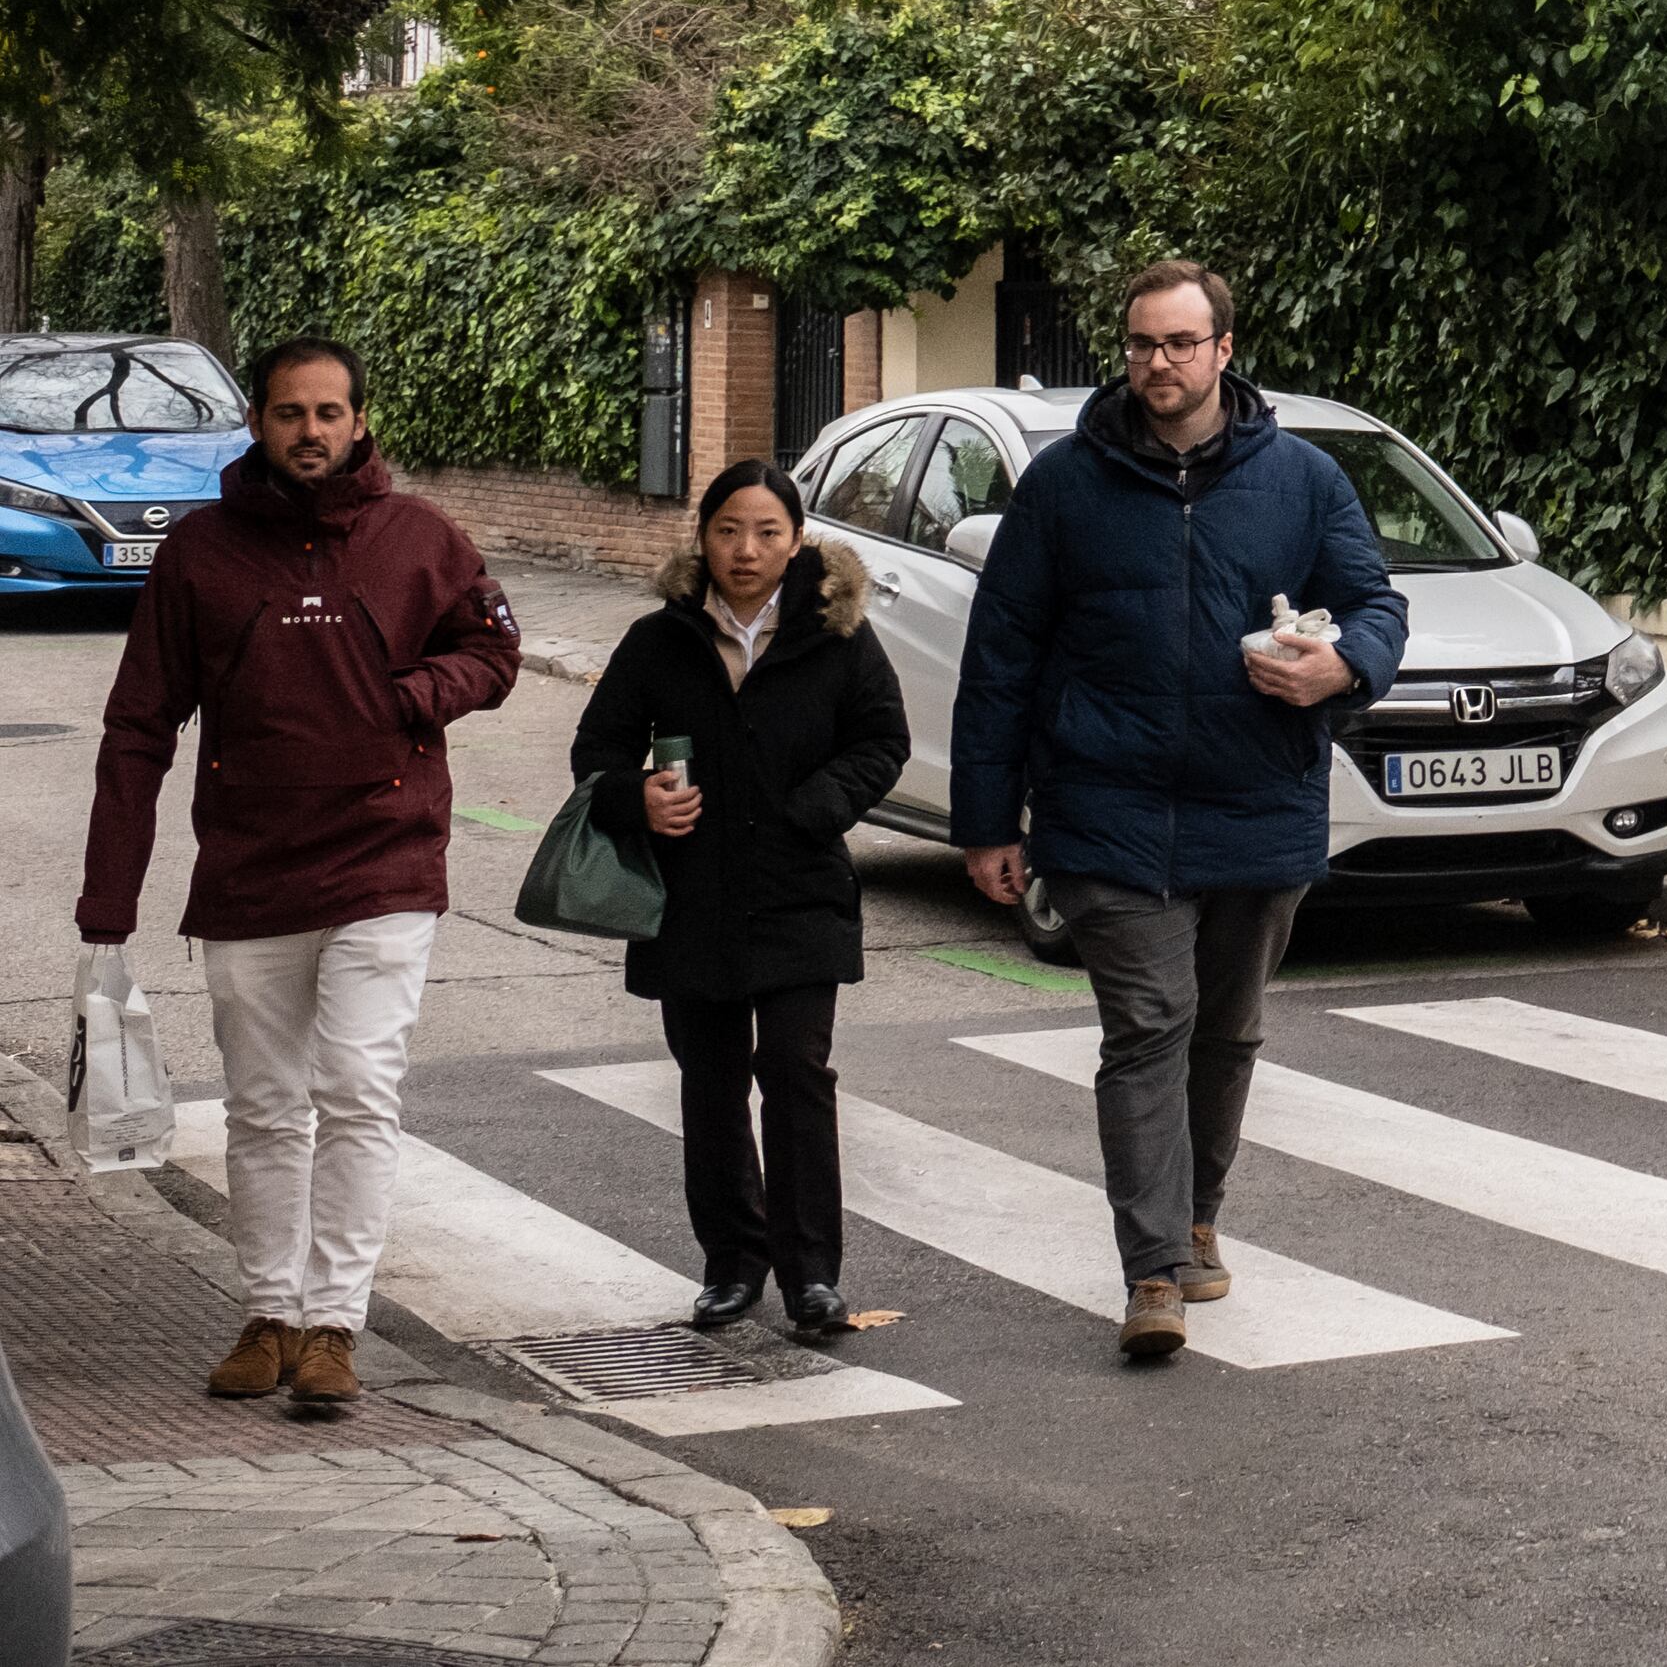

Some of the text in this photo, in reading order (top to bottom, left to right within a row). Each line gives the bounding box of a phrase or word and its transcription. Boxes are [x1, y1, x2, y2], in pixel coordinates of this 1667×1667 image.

[118, 546, 153, 563] 355
[282, 615, 343, 624] MONTEC
[1391, 754, 1554, 789] E 0643 JLB
